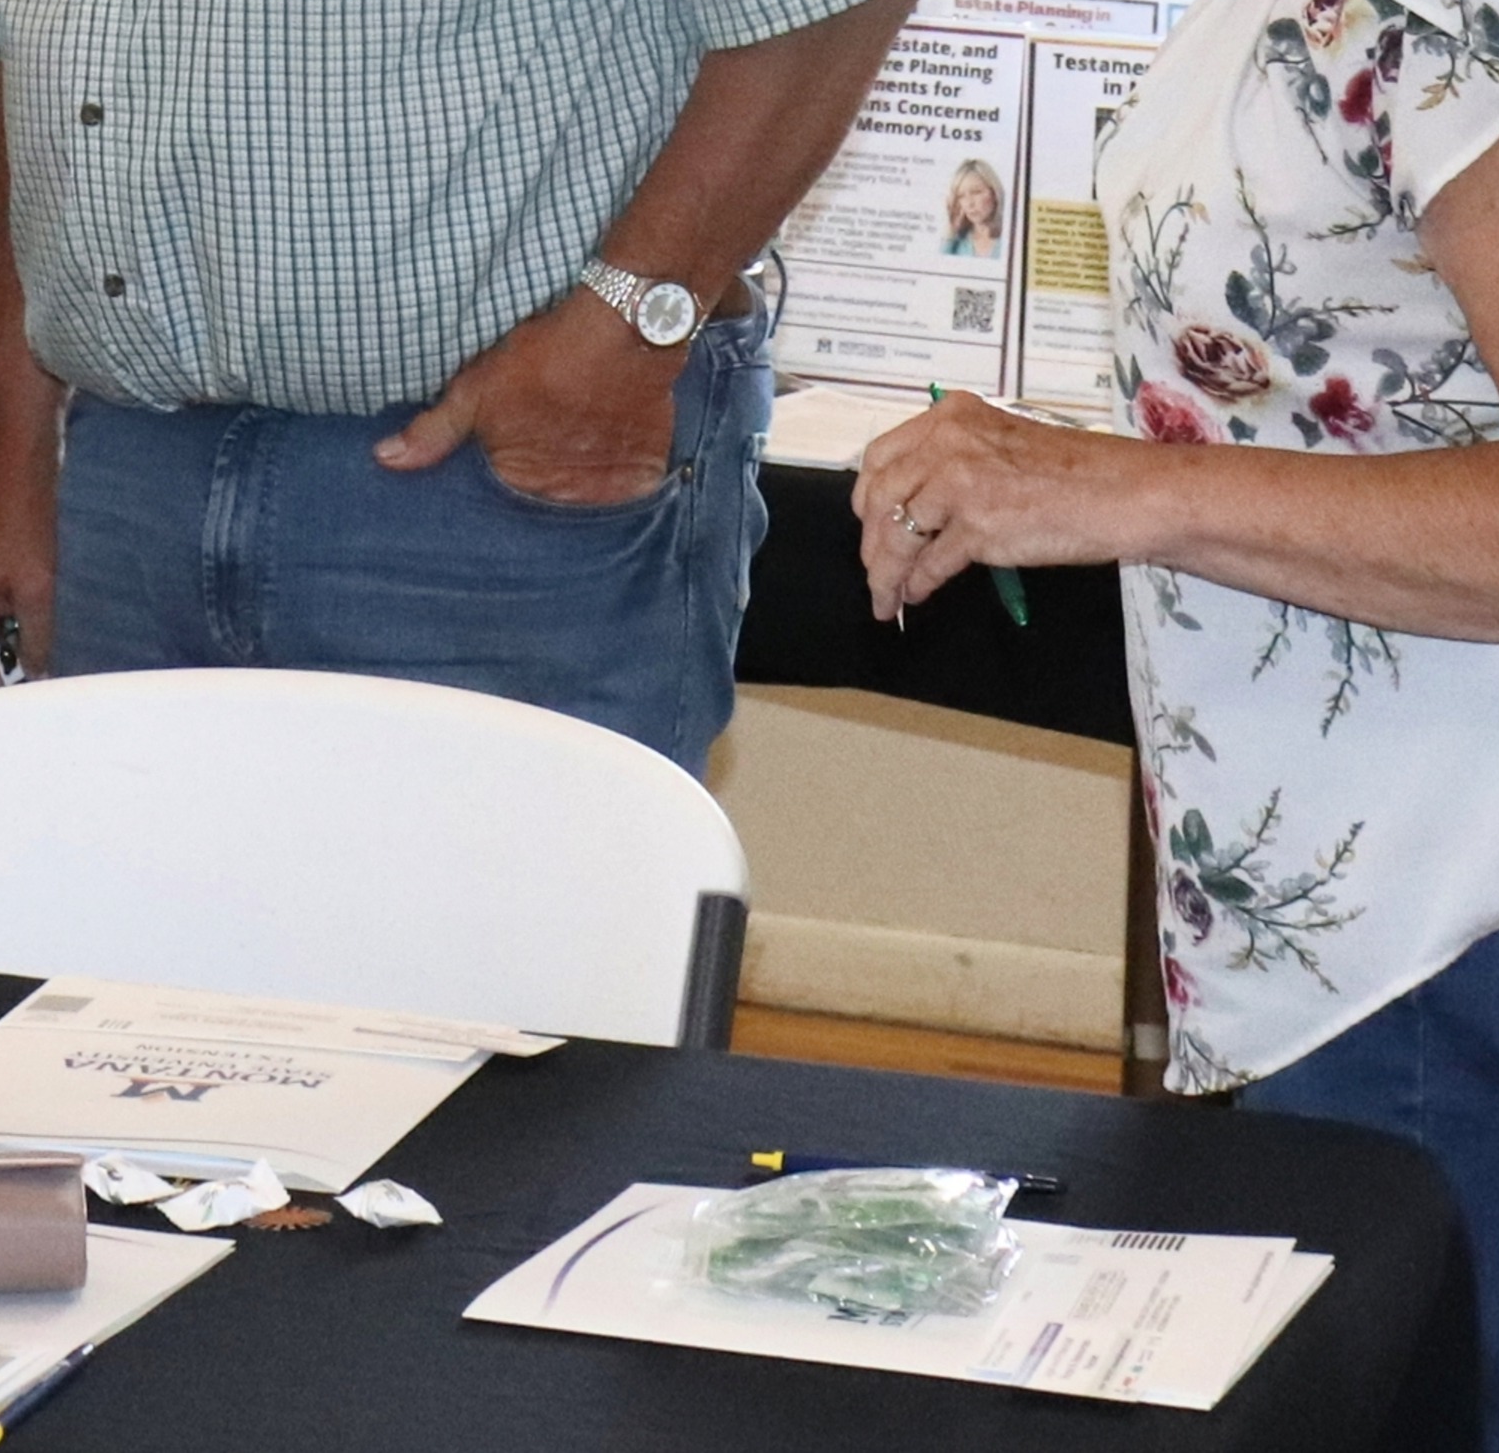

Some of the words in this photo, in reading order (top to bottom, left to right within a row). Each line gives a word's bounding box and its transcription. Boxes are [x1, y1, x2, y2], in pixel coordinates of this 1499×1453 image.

[1095, 6, 1112, 21] in
[890, 36, 957, 58] Estate,
[962, 42, 998, 59] and
[909, 58, 993, 84] Planning
[1053, 52, 1150, 76] Testame
[933, 80, 962, 97] for
[1103, 77, 1122, 95] in
[897, 98, 1000, 123] Concerned
[856, 116, 936, 143] Memory
[940, 124, 983, 142] Loss
[73, 1050, 238, 1071] UNIVERSITY
[135, 1043, 294, 1063] EXTENSION
[64, 1057, 324, 1089] MONTANA
